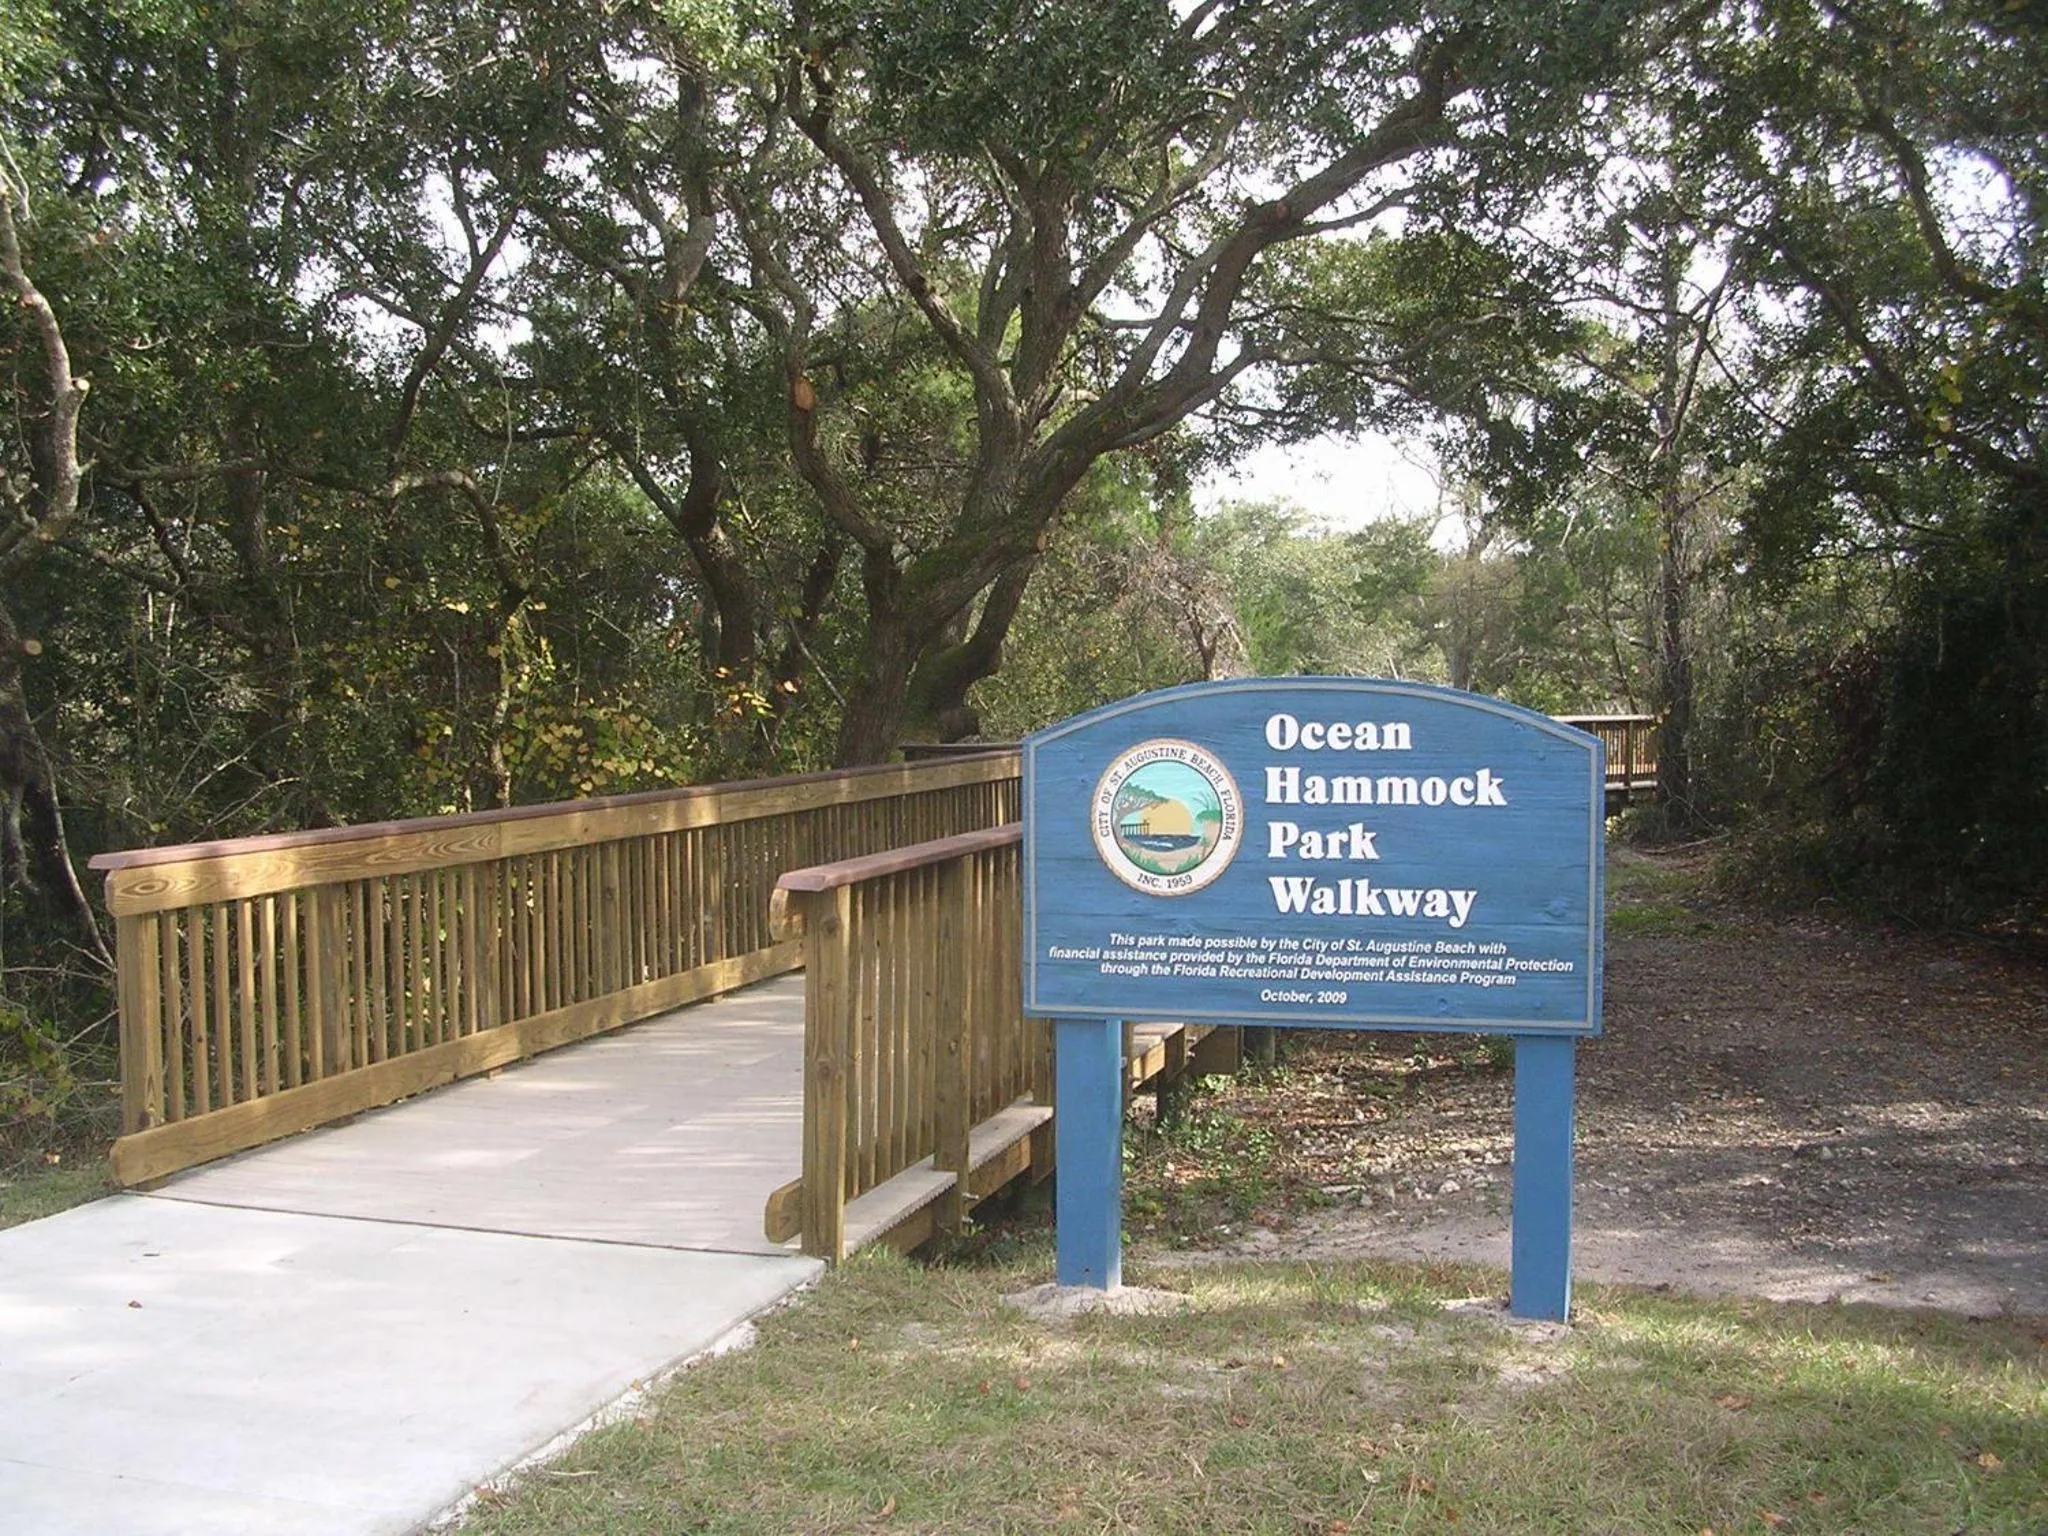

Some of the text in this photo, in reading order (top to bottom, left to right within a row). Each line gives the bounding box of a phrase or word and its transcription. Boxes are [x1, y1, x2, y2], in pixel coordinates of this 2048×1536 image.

[1265, 714, 1412, 750] Ocean
[1124, 748, 1187, 770] AUGUSTINE
[1101, 789, 1113, 803] OF
[1265, 767, 1508, 806] Hammock
[1098, 811, 1109, 838] CITY
[1220, 789, 1236, 841] FLORIDA
[1268, 822, 1380, 859] Park
[1137, 873, 1161, 888] INC.
[1268, 877, 1478, 928] Walkway
[1111, 933, 1506, 954] This park made possible by the City of St. Augustine Beach with
[1049, 947, 1573, 971] financial assistance provided by the Florida Department of Environmental Protection
[1101, 963, 1516, 986] through the Florida Recreational Development Assistance Program
[1261, 989, 1346, 1003] October, 2009
